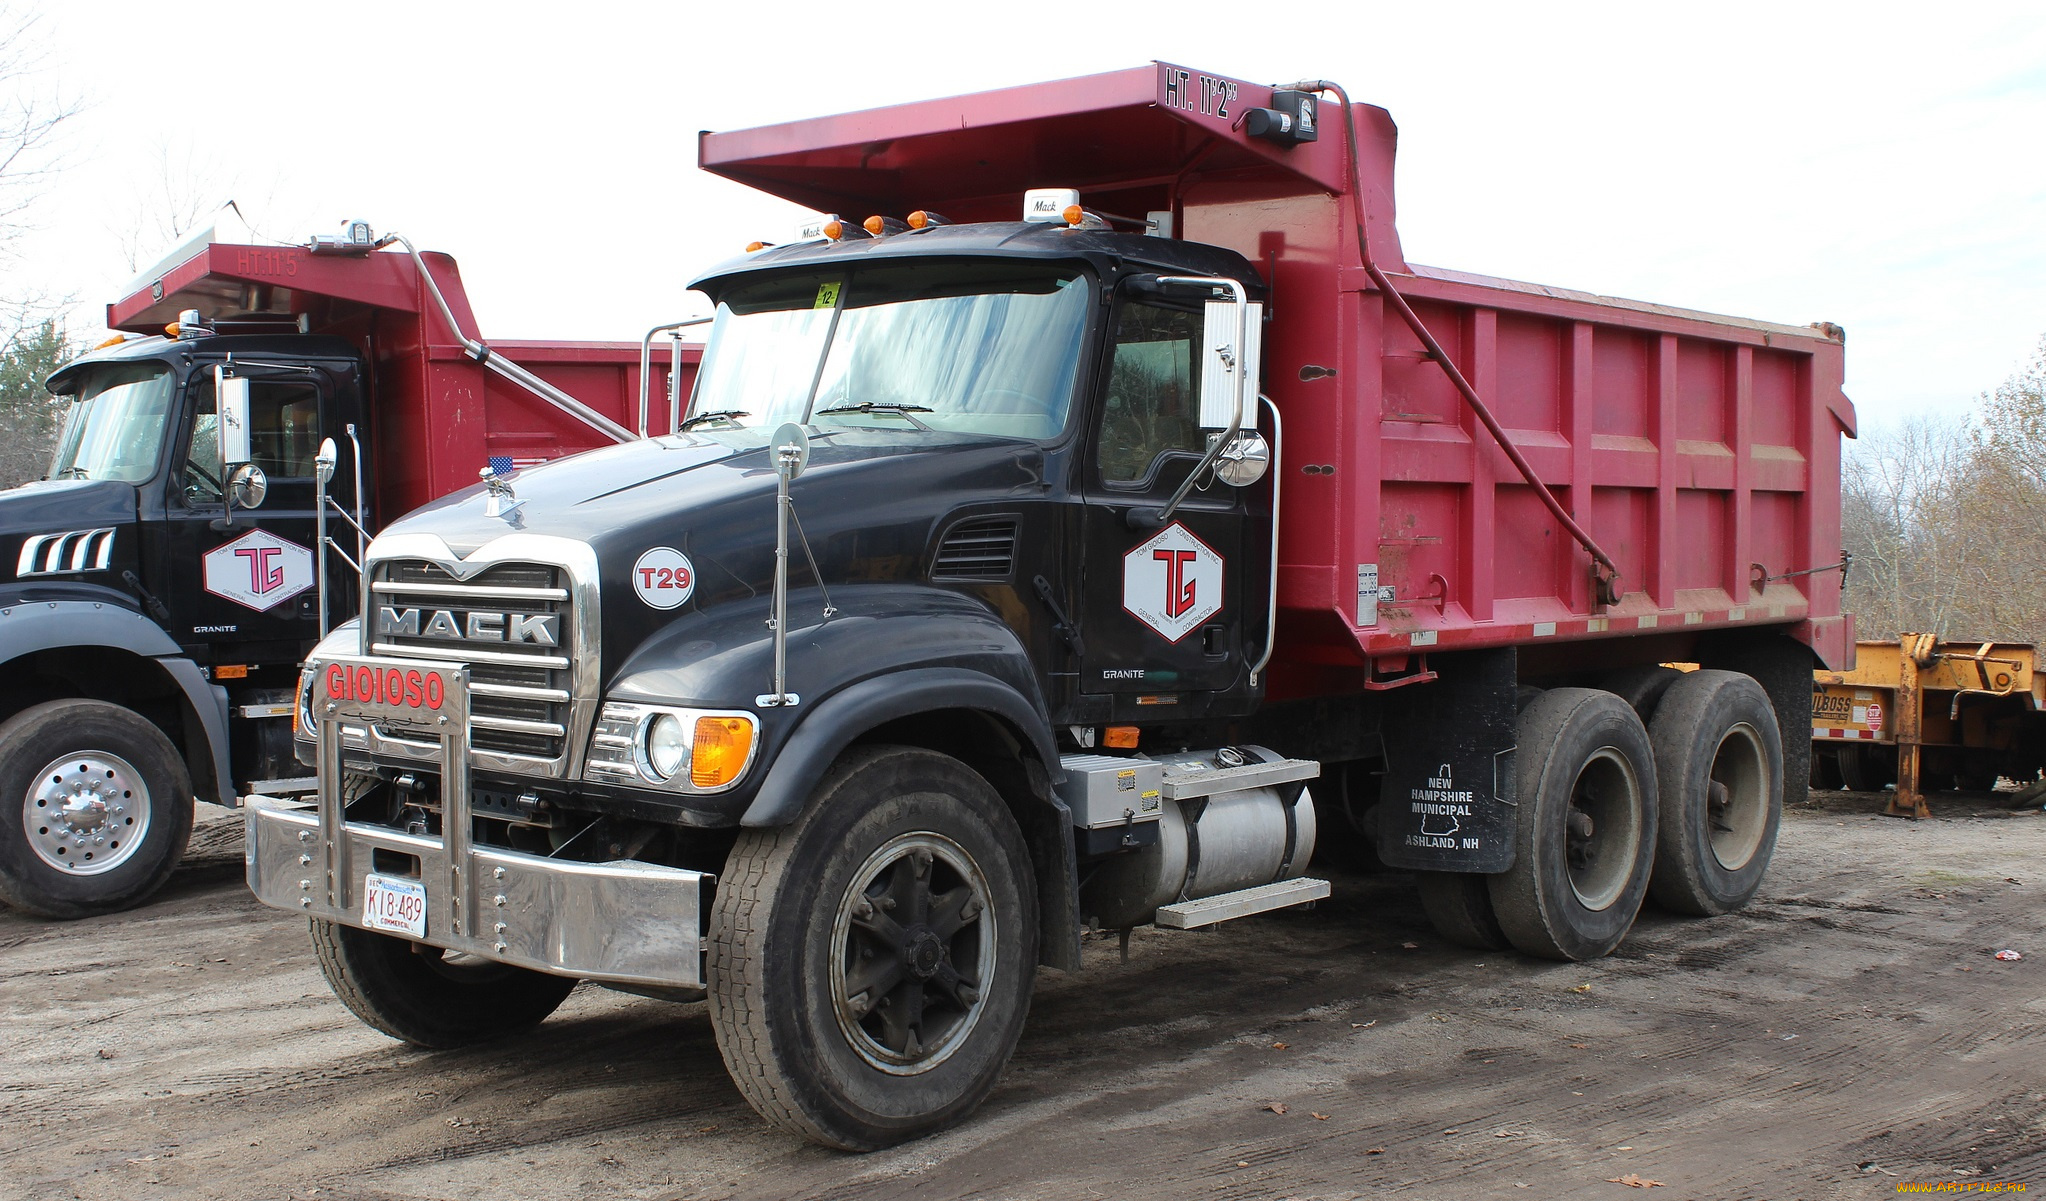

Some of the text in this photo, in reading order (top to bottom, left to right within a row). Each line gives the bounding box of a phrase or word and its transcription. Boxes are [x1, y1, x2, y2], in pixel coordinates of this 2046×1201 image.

[1033, 201, 1056, 212] Mack
[802, 226, 821, 240] Mack
[822, 291, 833, 304] 12
[257, 532, 297, 552] CONSTRUCTION
[1175, 527, 1211, 557] CONSTRUCTION
[638, 567, 691, 589] T29
[222, 588, 247, 602] GENERAL
[271, 583, 304, 603] CONTRACTOR
[379, 607, 557, 645] MACK
[1138, 605, 1213, 632] GENERAL CONTRACTOR
[326, 663, 444, 710] GIOIOSO
[1428, 777, 1452, 789] NEW
[1411, 789, 1473, 802] HAMPSHIRE
[1412, 802, 1472, 816] MUNICIPAL
[1405, 834, 1479, 850] ASHLAND, NH
